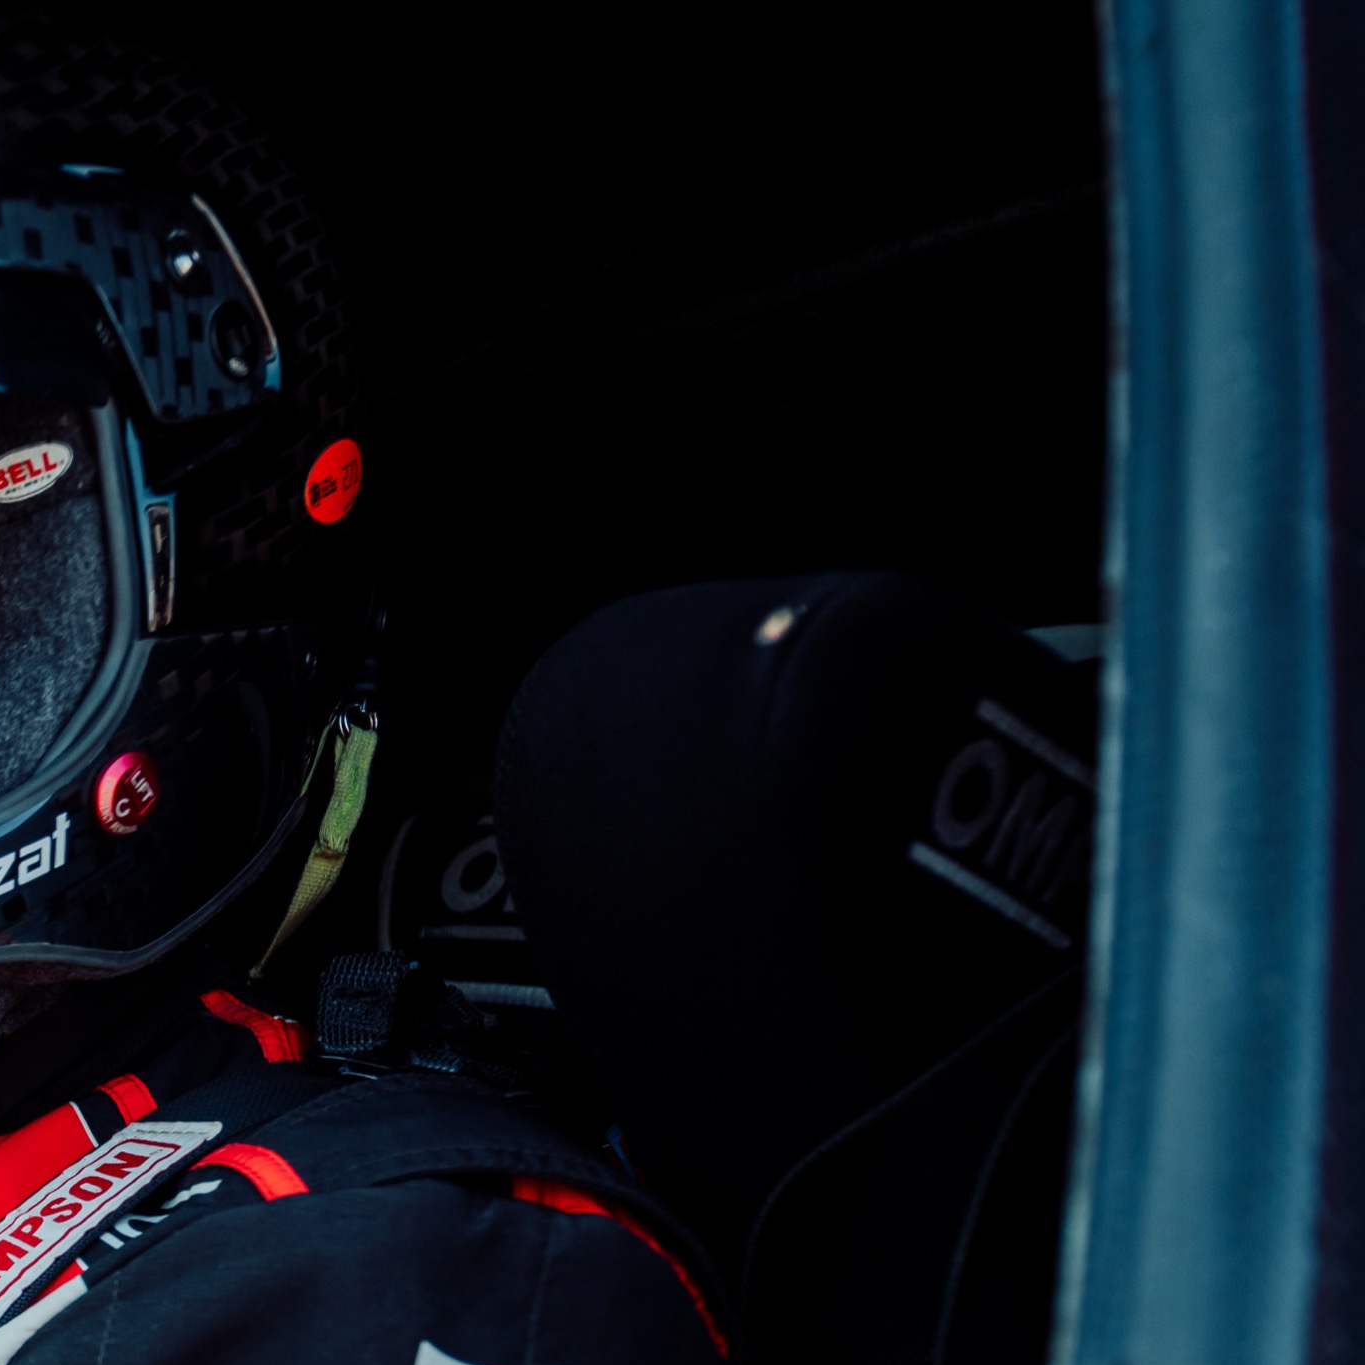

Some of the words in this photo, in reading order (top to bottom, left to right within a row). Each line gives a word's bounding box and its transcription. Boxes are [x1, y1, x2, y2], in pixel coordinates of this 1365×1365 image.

[130, 770, 155, 802] LIFT
[115, 798, 131, 818] C
[930, 736, 1089, 908] OM
